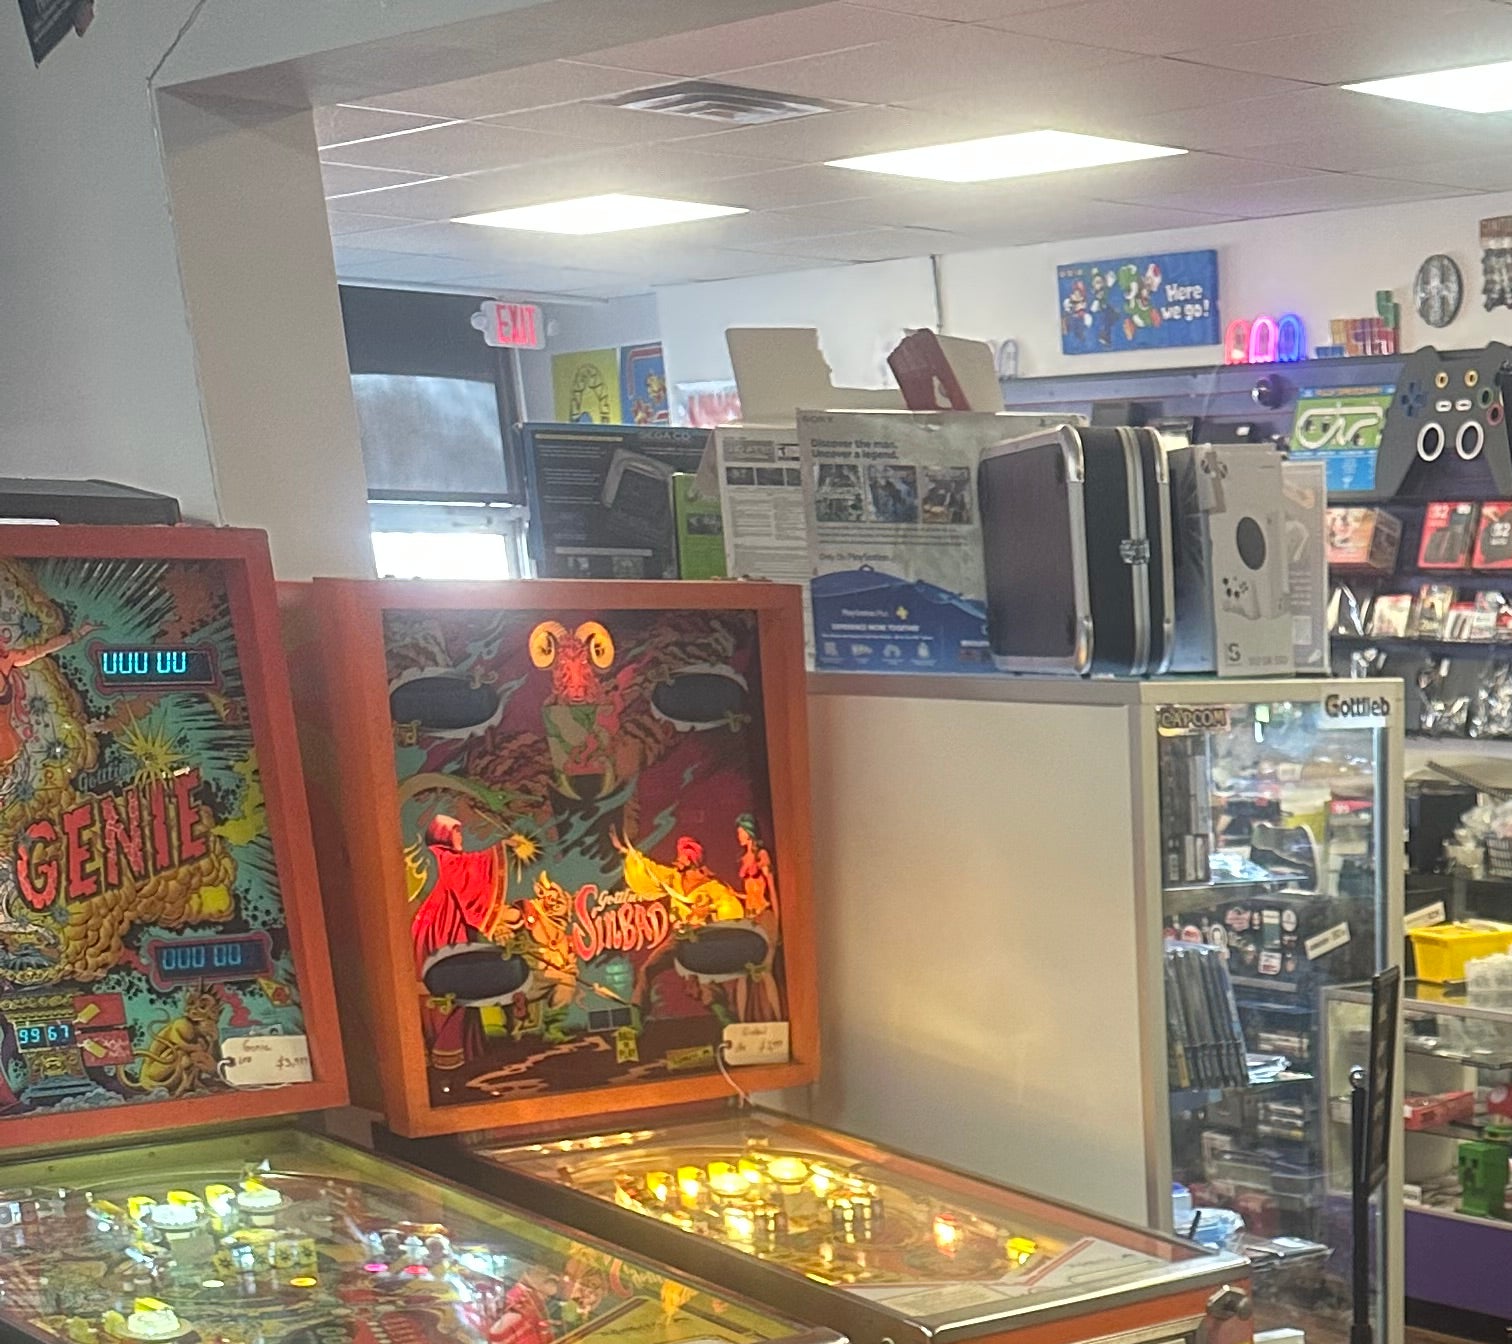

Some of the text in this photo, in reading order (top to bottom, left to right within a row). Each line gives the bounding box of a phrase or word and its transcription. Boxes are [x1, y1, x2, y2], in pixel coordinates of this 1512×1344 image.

[1165, 283, 1203, 302] Here
[1161, 300, 1210, 322] we go!
[496, 304, 538, 346] EXIT
[810, 438, 853, 448] Discover
[855, 439, 871, 448] the
[1325, 692, 1390, 719] Gottlieb
[1160, 707, 1229, 730] CAPCOM
[16, 768, 207, 911] GENIE
